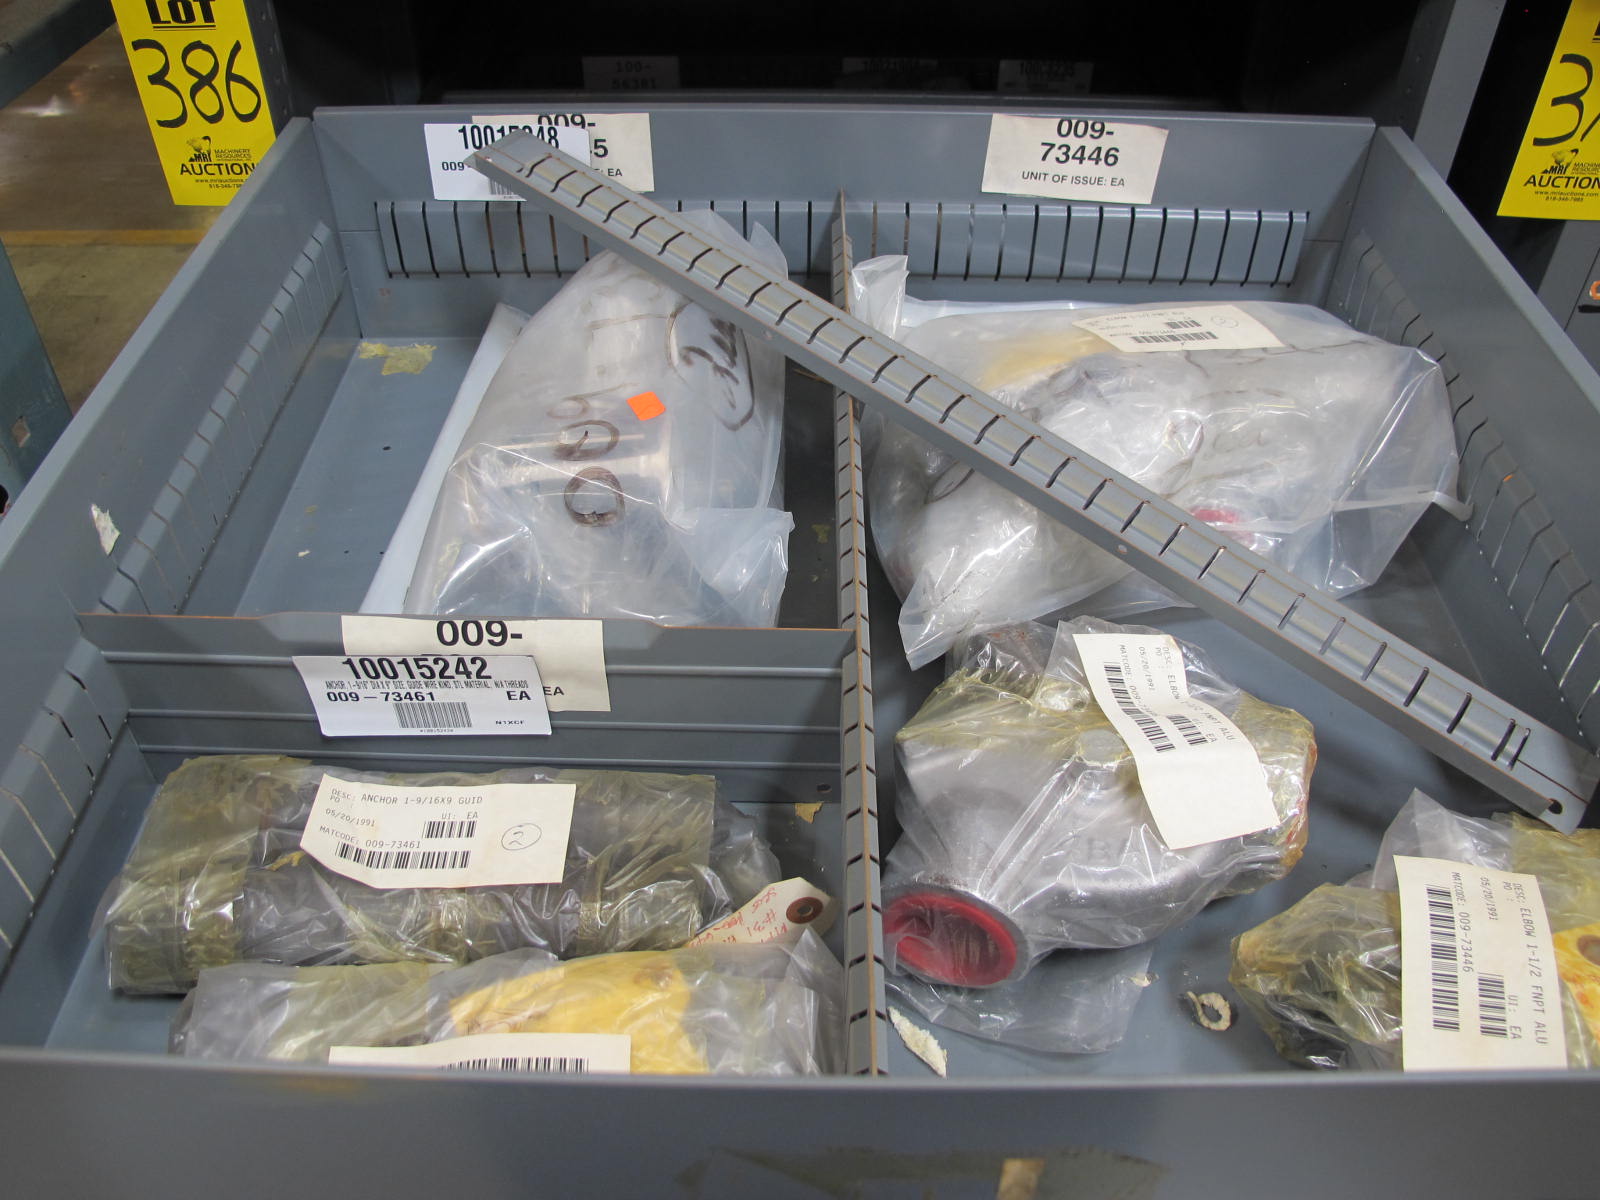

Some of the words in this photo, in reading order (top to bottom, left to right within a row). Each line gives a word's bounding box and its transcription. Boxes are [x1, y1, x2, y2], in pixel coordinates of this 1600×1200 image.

[131, 38, 262, 129] 386
[1532, 53, 1600, 147] 3
[1056, 118, 1115, 140] 009-
[1040, 142, 1120, 167] 73446
[607, 168, 623, 177] EA
[1021, 170, 1049, 182] UNIT
[1051, 174, 1068, 184] OF
[1070, 175, 1107, 186] ISSUE:
[1110, 177, 1125, 187] EA
[436, 619, 523, 647] 009-
[340, 656, 492, 680] 10015242
[506, 690, 532, 701] EA
[543, 686, 565, 697] EA
[1205, 732, 1218, 743] EA
[361, 793, 398, 804] ANCHOR
[404, 796, 453, 805] 1-9/16X9
[458, 796, 483, 805] GUID
[325, 808, 375, 827] 05/20/1991
[466, 811, 479, 820] EA
[319, 825, 359, 845] MATCODE:
[365, 839, 421, 849] 009-73461
[1451, 871, 1466, 906] MATCODE:
[1479, 877, 1498, 921] 05/20/1991
[1512, 882, 1523, 903] DESC:
[1520, 907, 1537, 937] ELBOW
[1458, 911, 1474, 973] 009-73446
[1526, 944, 1542, 978] 1-1/2
[1531, 985, 1546, 1014] FNPT
[1510, 1025, 1522, 1040] EA
[1534, 1021, 1548, 1045] ALU
